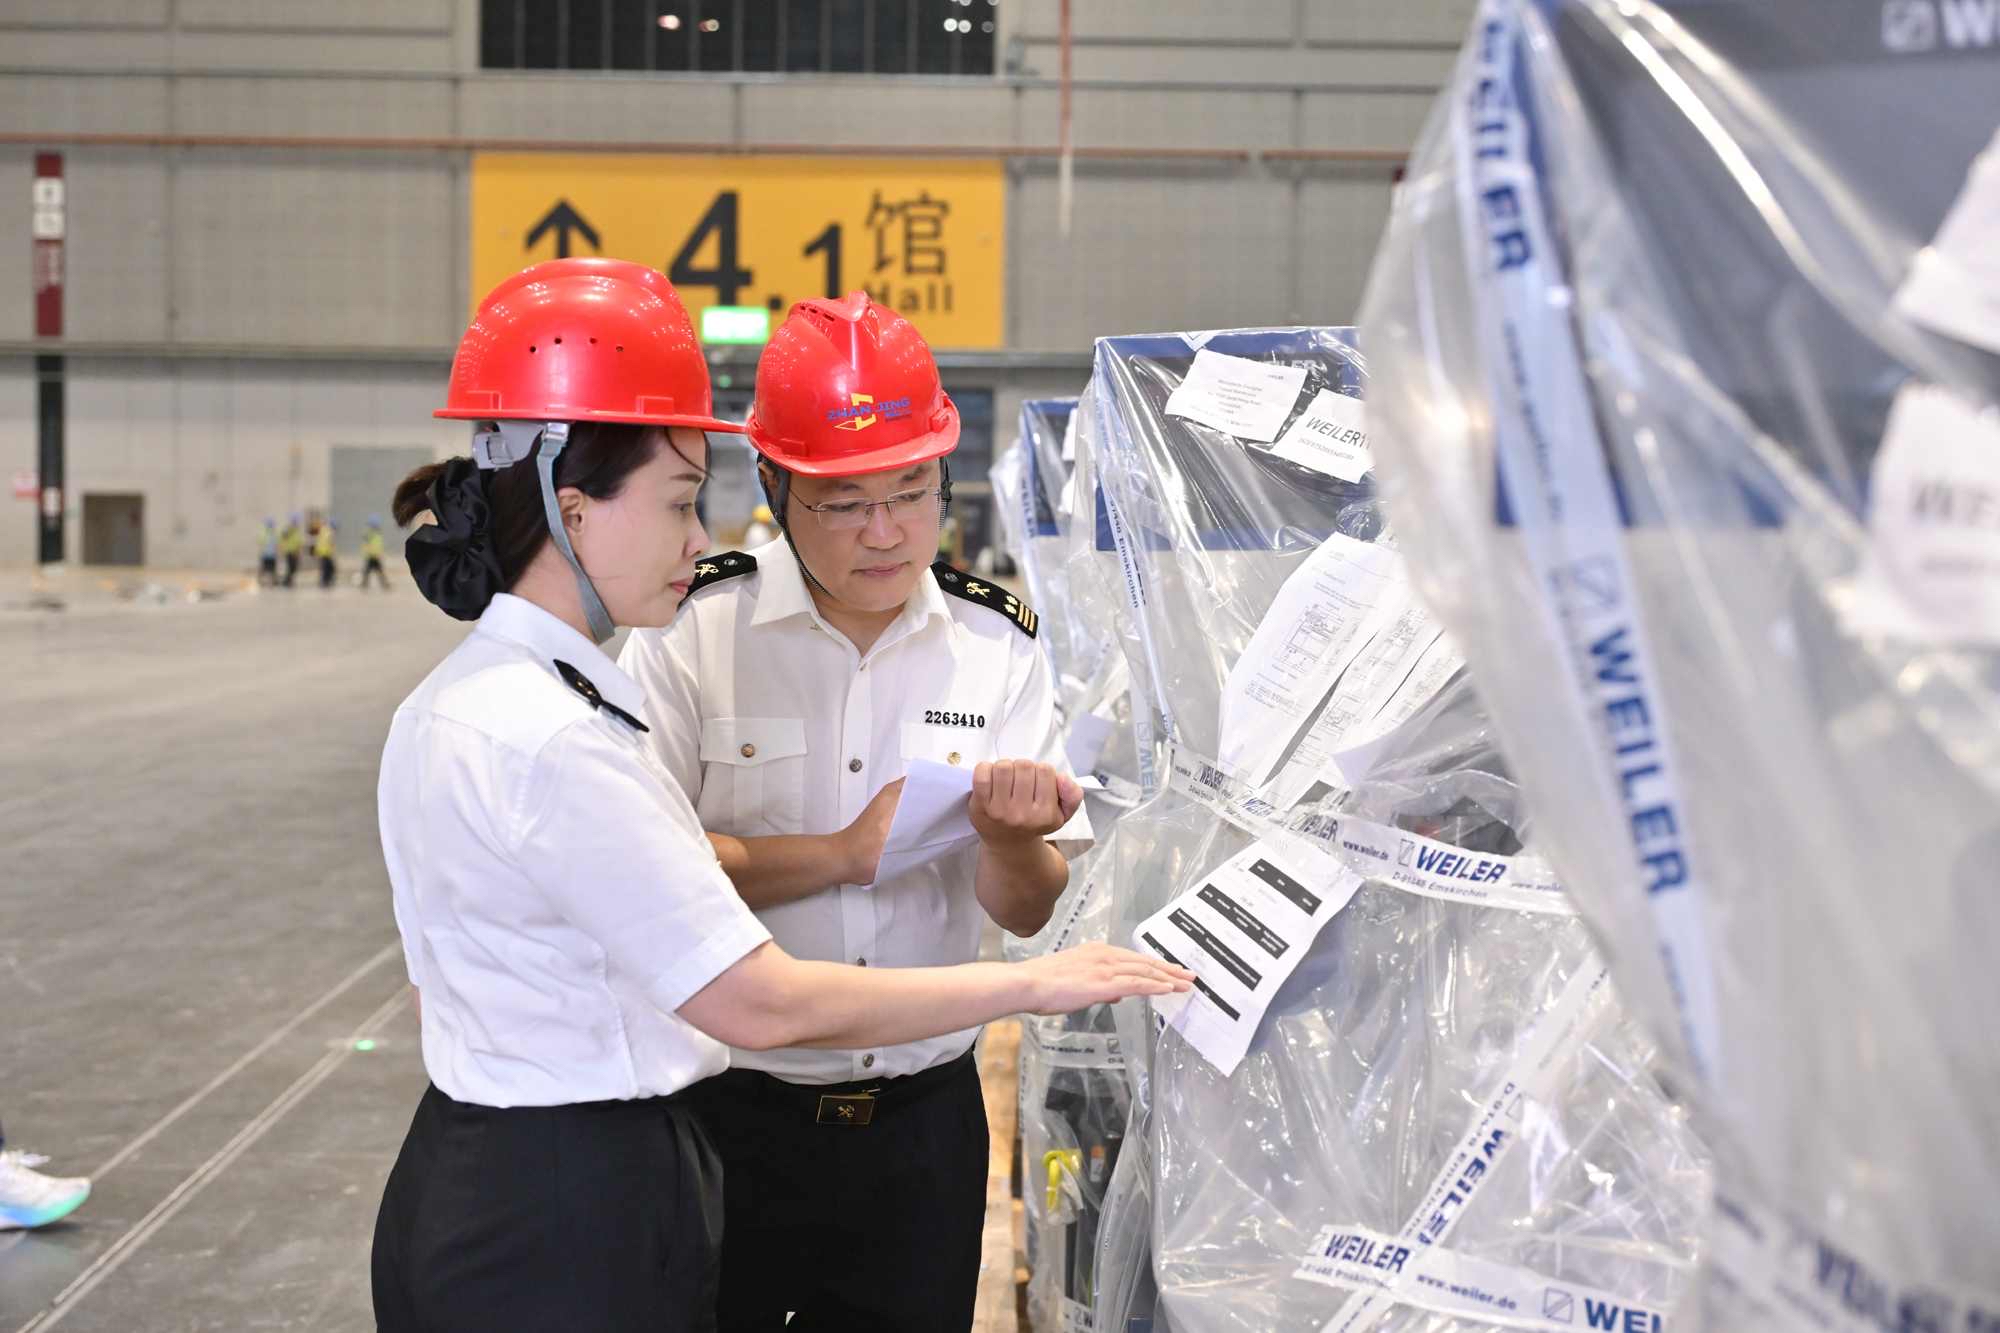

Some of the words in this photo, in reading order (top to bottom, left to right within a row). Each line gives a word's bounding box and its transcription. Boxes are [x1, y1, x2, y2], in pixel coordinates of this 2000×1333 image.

[864, 188, 951, 275] 馆
[865, 284, 953, 312] Hall
[925, 710, 986, 728] 2263410
[1590, 627, 1690, 894] WEILER
[1416, 845, 1507, 885] WEILER
[1325, 1233, 1410, 1273] WEILER
[1417, 1274, 1517, 1310] www.weiler.de
